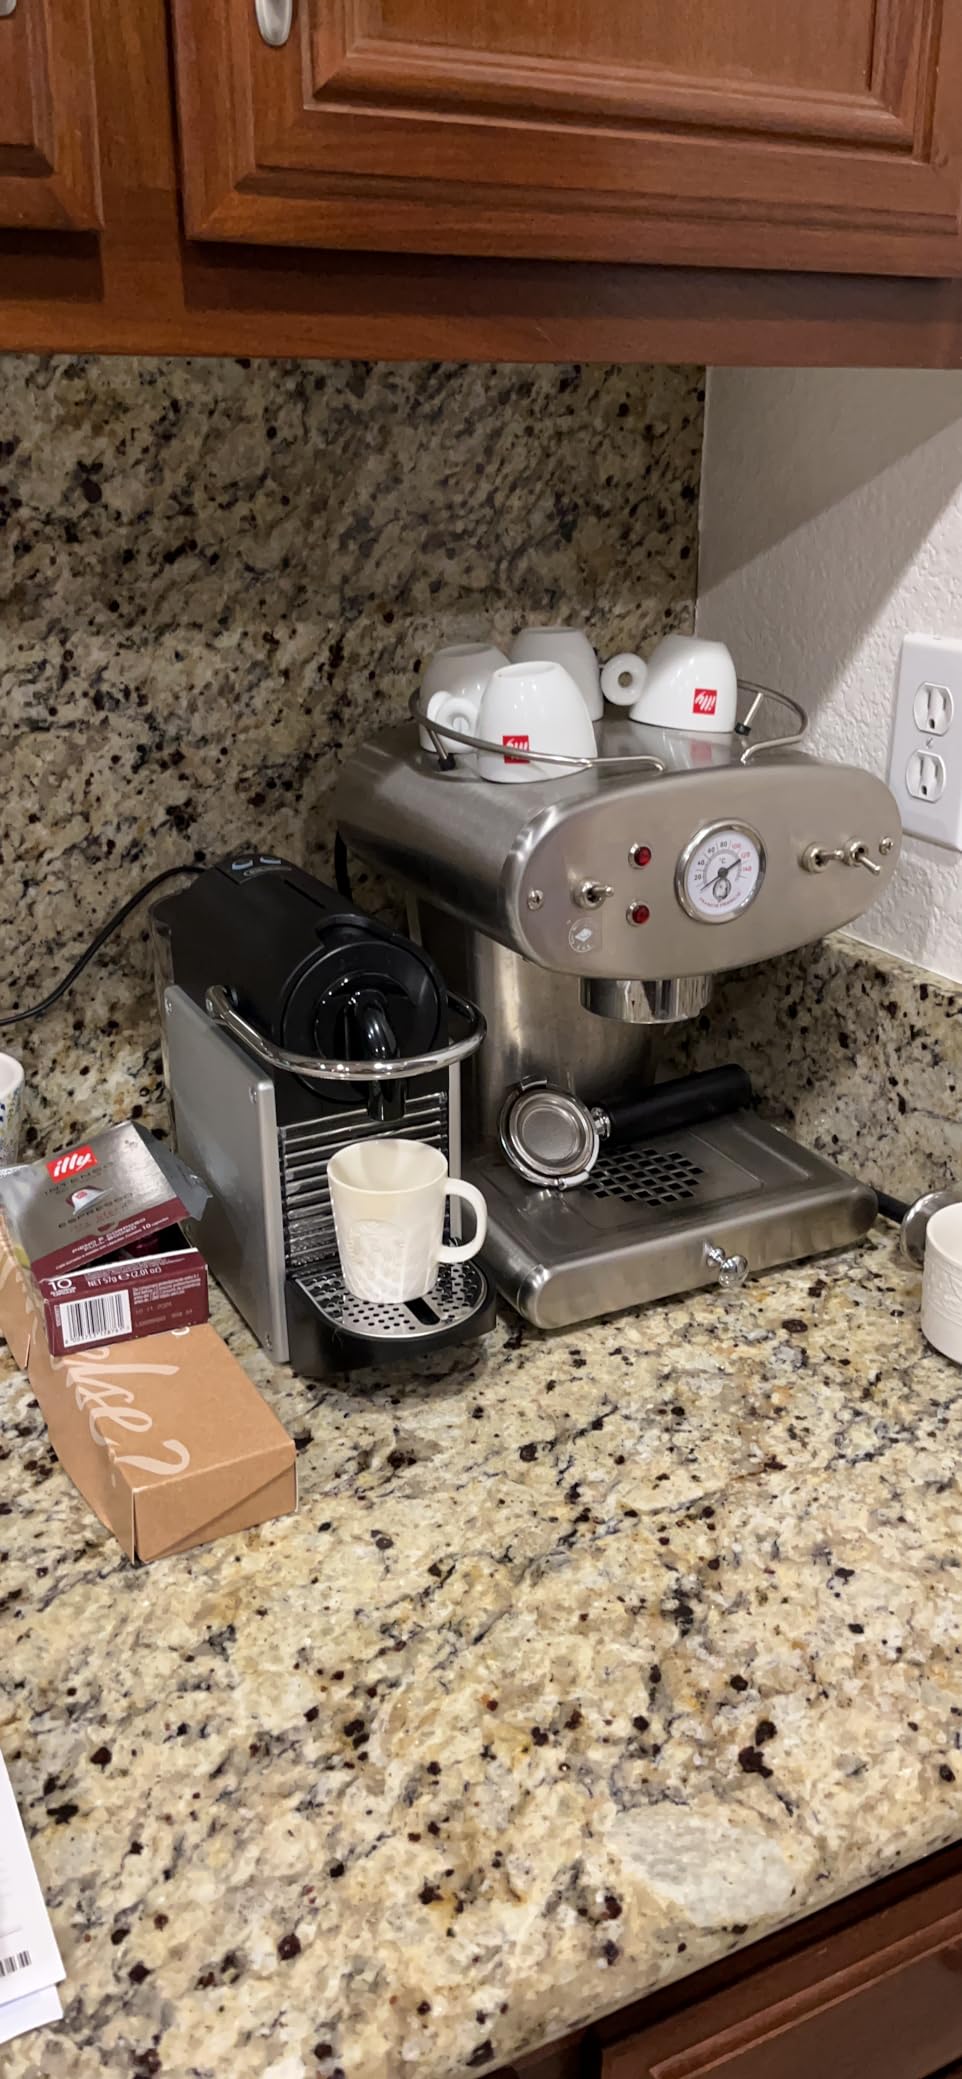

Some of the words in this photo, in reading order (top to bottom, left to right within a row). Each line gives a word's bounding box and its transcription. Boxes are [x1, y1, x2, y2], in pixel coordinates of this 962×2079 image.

[695, 690, 716, 712] illy
[53, 1151, 92, 1177] illy
[48, 1278, 72, 1290] 10
[87, 1278, 101, 1287] NET
[102, 1274, 117, 1284] 57g
[149, 1265, 162, 1274] oz)
